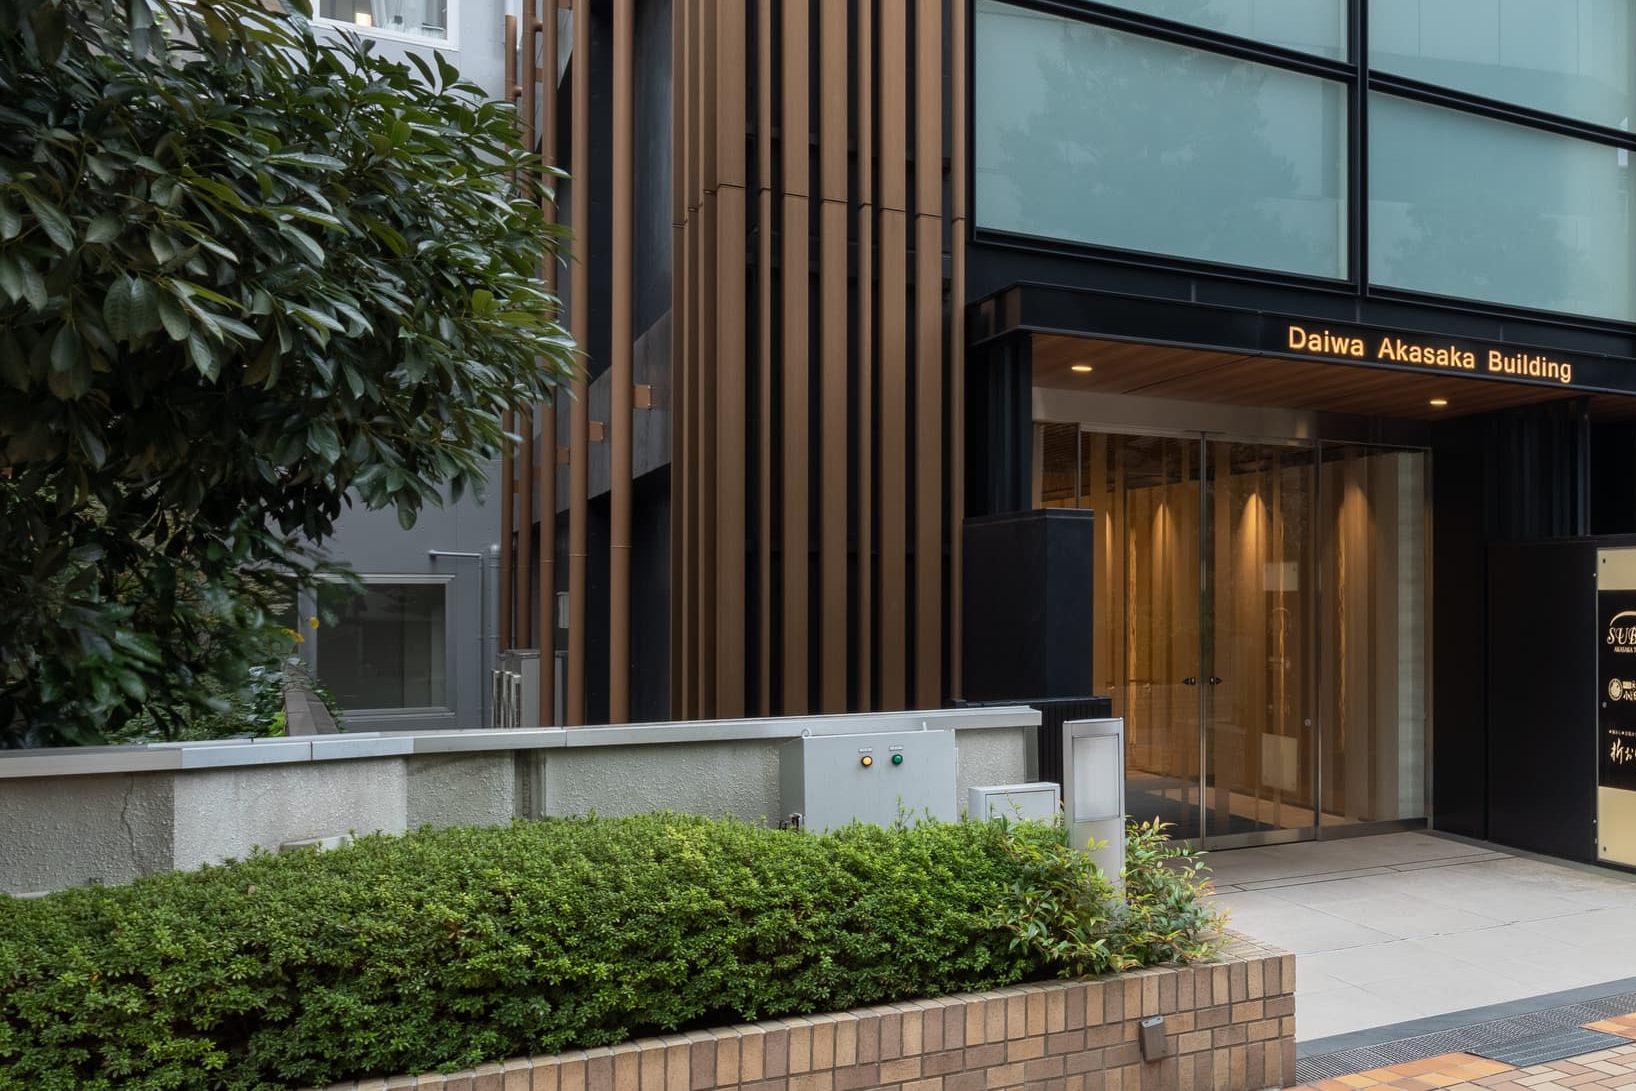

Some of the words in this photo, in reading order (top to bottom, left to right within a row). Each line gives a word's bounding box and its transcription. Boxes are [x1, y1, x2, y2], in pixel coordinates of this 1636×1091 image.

[1288, 325, 1365, 357] Daiwa
[1377, 337, 1476, 369] Akasaka
[1488, 349, 1572, 384] Building
